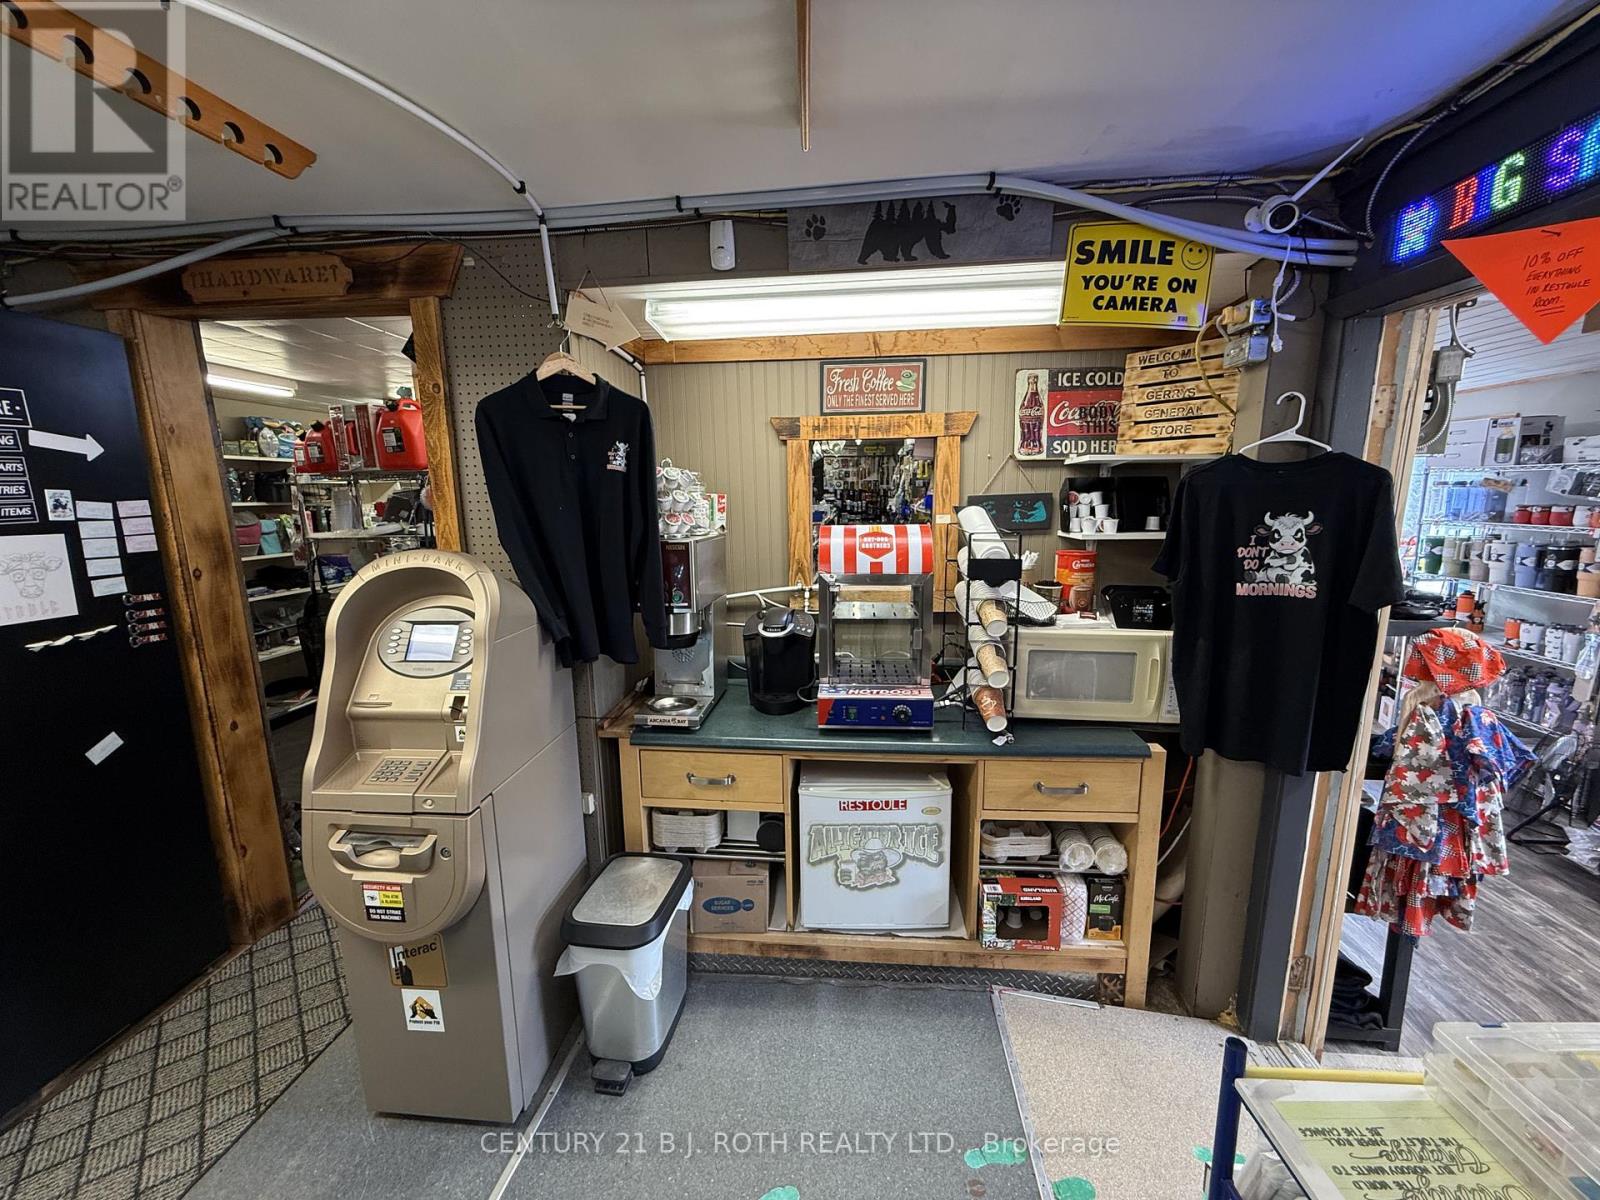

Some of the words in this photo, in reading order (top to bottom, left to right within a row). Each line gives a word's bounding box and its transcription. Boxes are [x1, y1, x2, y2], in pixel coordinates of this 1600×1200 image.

[1074, 239, 1176, 266] SMILE
[1523, 251, 1552, 270] 10%
[1557, 246, 1585, 262] OFF
[199, 265, 330, 288] HARDWARE
[1525, 264, 1582, 282] EVERYTHING
[1081, 274, 1159, 293] YOU'RE
[1167, 277, 1198, 294] ON
[1526, 285, 1540, 296] IN
[1092, 295, 1178, 314] CAMERA
[1138, 347, 1198, 366] WELCOM
[826, 368, 860, 395] Fresh
[862, 367, 895, 393] Coffee
[1057, 372, 1081, 387] ICE
[1085, 371, 1124, 386] COLD
[1162, 368, 1179, 379] TO
[827, 394, 842, 408] ONLY
[843, 394, 855, 407] THE
[855, 393, 875, 406] FINEST
[875, 393, 899, 406] SERVED
[899, 392, 915, 406] HERE
[1145, 387, 1196, 400] GERRYS
[1150, 424, 1192, 435] STORE
[1052, 440, 1087, 454] SOLD
[1, 507, 32, 517] ITEMS
[1248, 535, 1256, 546] I
[1236, 546, 1270, 558] DON'T
[371, 553, 464, 573] MINI-BANK
[1243, 559, 1260, 570] DO
[1236, 582, 1318, 600] MORNINGS
[839, 800, 907, 811] RESTOULE
[1331, 1165, 1351, 1176] TO
